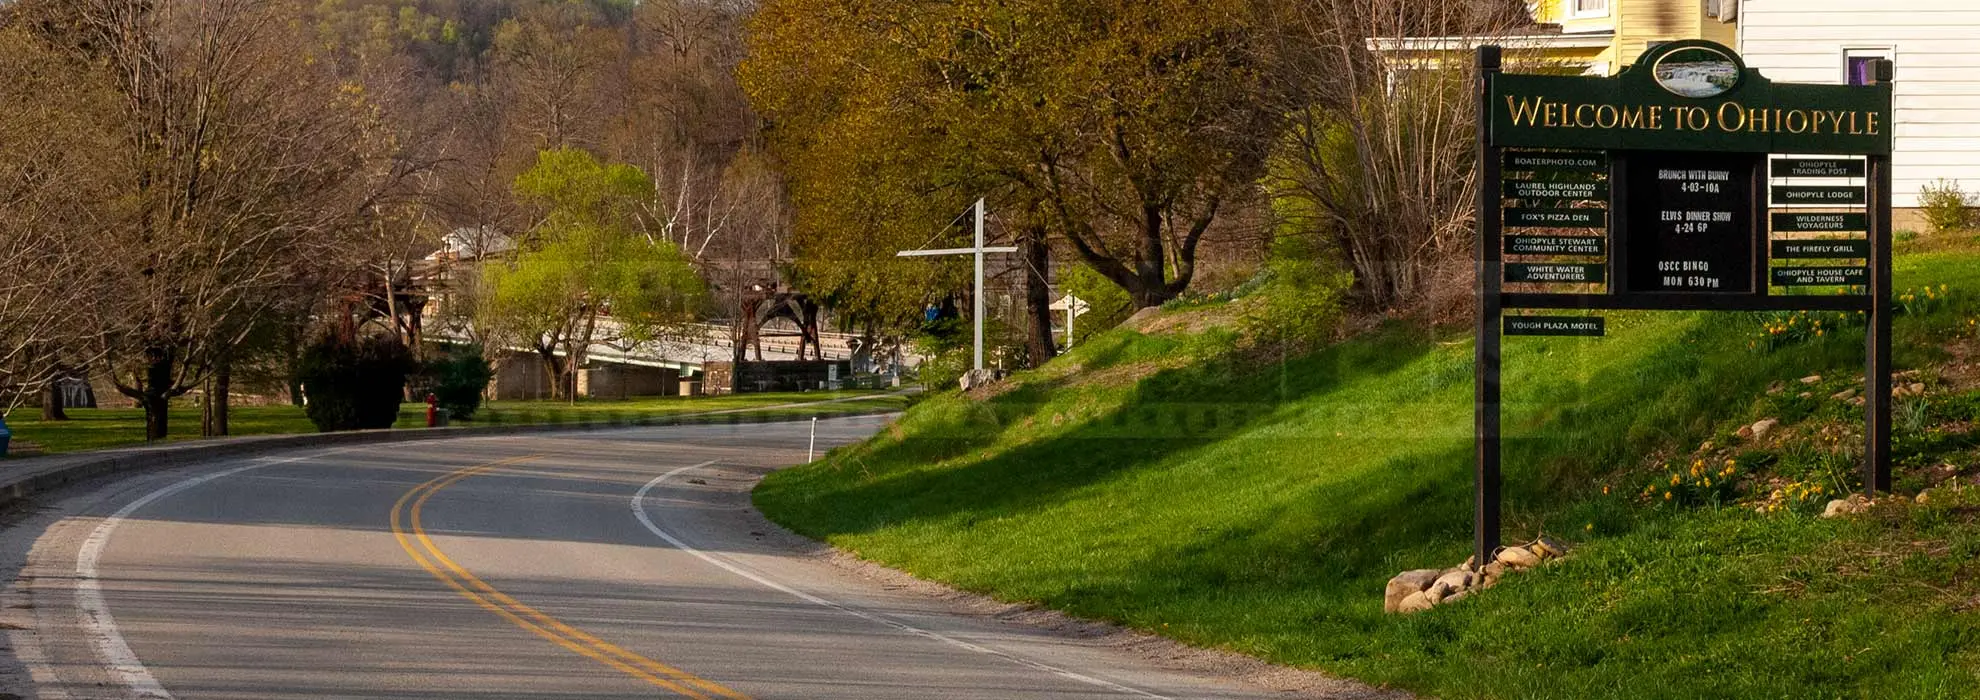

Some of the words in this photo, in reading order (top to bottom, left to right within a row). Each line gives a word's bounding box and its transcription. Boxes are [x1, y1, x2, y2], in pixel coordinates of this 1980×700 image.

[1514, 158, 1597, 167] BOATERPHOTO.COM
[1658, 169, 1686, 180] BRUNCH
[1688, 170, 1706, 180] WITH
[1707, 171, 1729, 181] BUNNY
[1549, 183, 1596, 191] HIGHLANDS
[1661, 211, 1682, 221] ELVIS
[1686, 211, 1710, 221] DINNER
[1712, 212, 1731, 222] SHOW
[1697, 223, 1708, 232] 6P
[1513, 244, 1565, 252] COMMUNITY
[1658, 261, 1680, 271] OSCC
[1683, 261, 1708, 271] BINGO
[1663, 276, 1682, 286] MON
[1688, 277, 1705, 286] 630
[1707, 277, 1719, 288] PM
